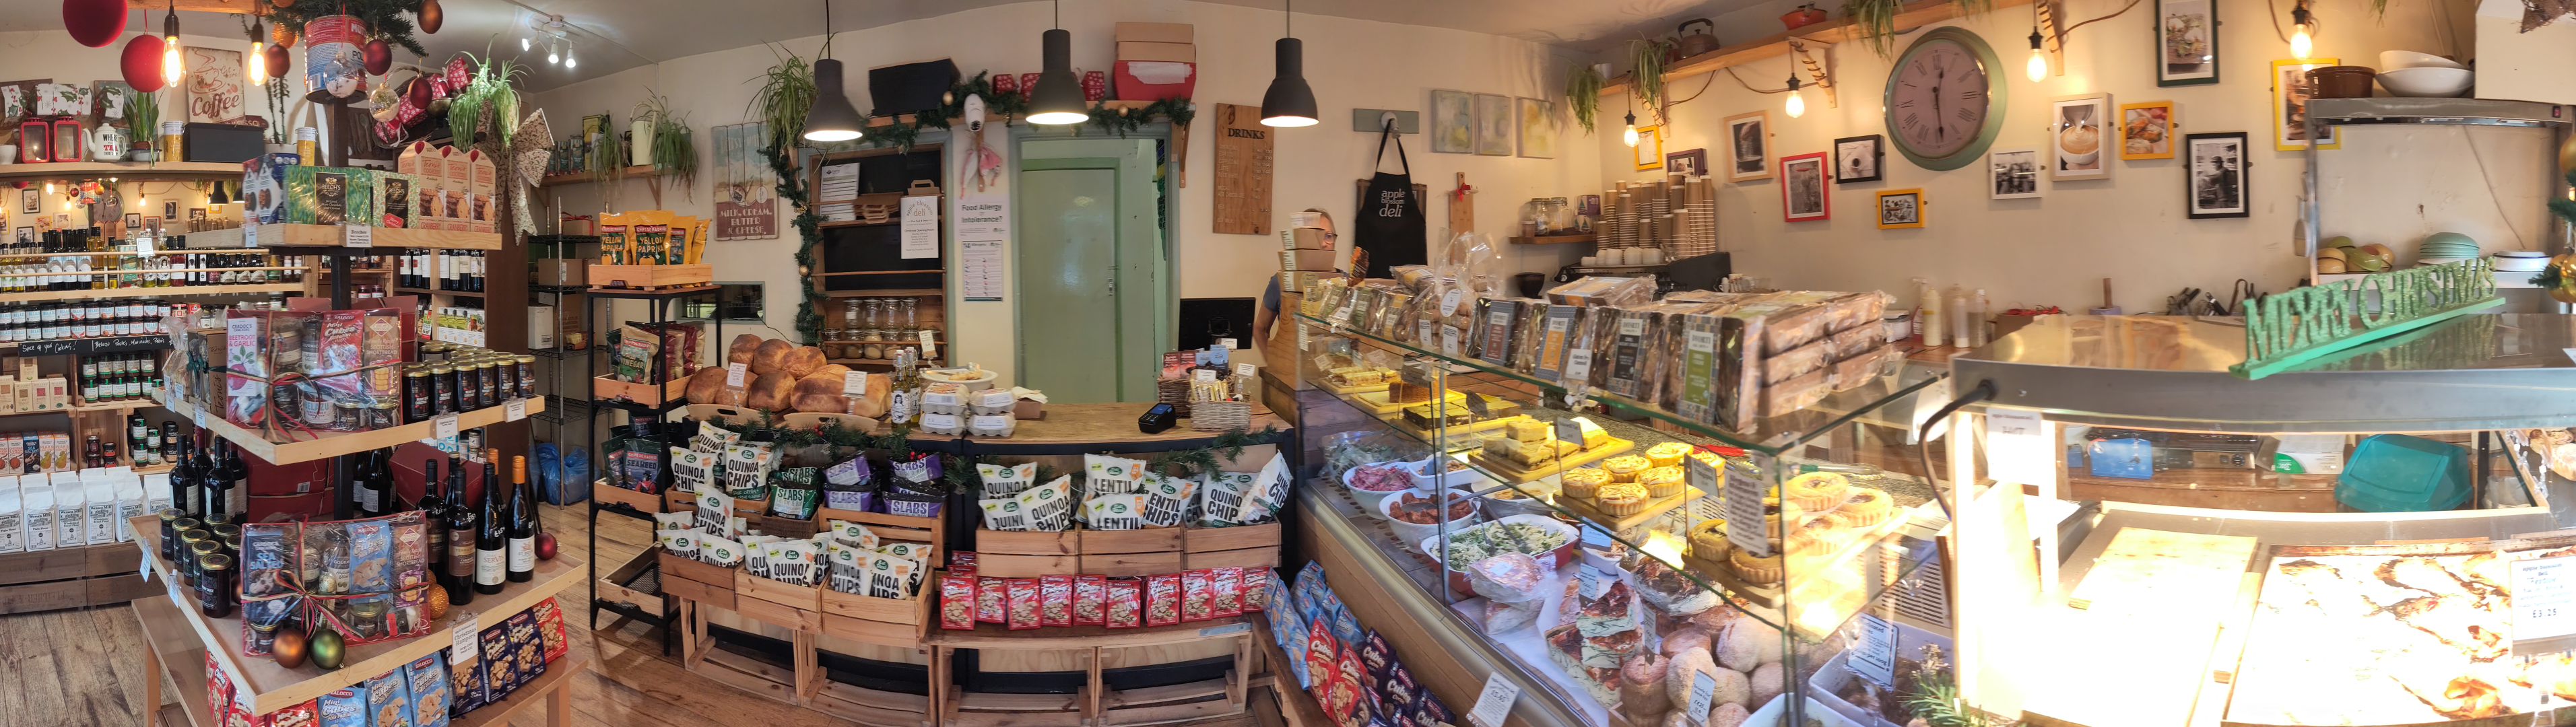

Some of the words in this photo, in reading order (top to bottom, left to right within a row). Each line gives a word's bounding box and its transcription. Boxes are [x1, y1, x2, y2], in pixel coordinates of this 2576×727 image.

[192, 91, 242, 118] Coffee
[1228, 128, 1265, 139] DRINKS
[1381, 188, 1406, 200] apple
[1379, 204, 1403, 217] deli
[731, 217, 760, 226] BUTTER
[2243, 278, 2356, 366] MERRY
[2358, 256, 2497, 330] CHRISTMAS
[325, 326, 359, 337] Cubes
[627, 459, 657, 469] SEAWEED
[728, 459, 759, 473] QUINOA
[894, 459, 925, 471] SLABS
[674, 463, 705, 480] QUINOA
[727, 472, 759, 489] CHIPS
[987, 481, 1028, 494] QUINOA
[1095, 478, 1133, 493] LENTIL
[777, 489, 803, 501] SLABS
[1147, 492, 1181, 512] ENTIL
[1210, 489, 1243, 507] QUINO
[893, 501, 927, 514] SLABS
[1032, 495, 1071, 520] QUINOA
[1208, 501, 1238, 522] CHIP
[1097, 517, 1139, 529] LENTIL
[257, 552, 275, 560] SEA
[834, 577, 861, 595] HIPS
[1311, 640, 1335, 660] Cubes
[1363, 646, 1385, 668] Cubes
[1387, 679, 1412, 703] Cubes
[321, 705, 356, 717] Cubes
